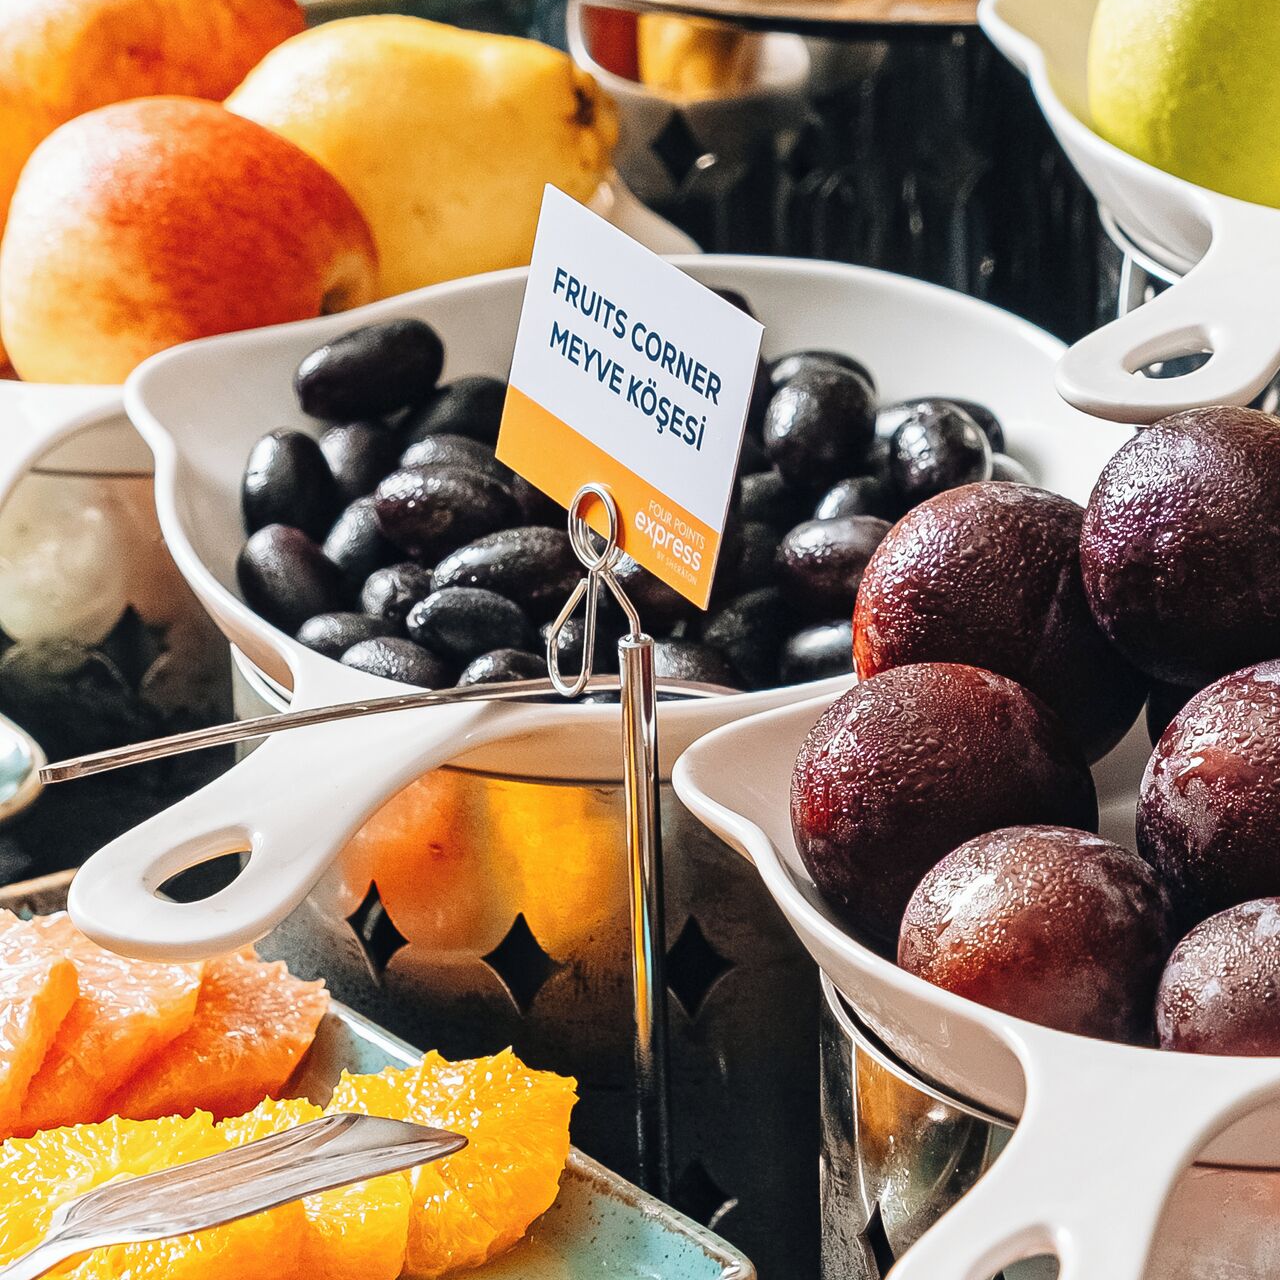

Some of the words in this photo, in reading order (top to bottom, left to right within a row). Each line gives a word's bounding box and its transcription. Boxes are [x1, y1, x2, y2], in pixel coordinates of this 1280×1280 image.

[552, 266, 628, 339] FRUITS
[631, 322, 722, 406] CORNER
[549, 320, 625, 395] MEYVE
[626, 375, 707, 451] KÖŞESİ
[634, 510, 702, 572] express
[648, 499, 673, 527] FOUR
[673, 517, 706, 550] POINTS
